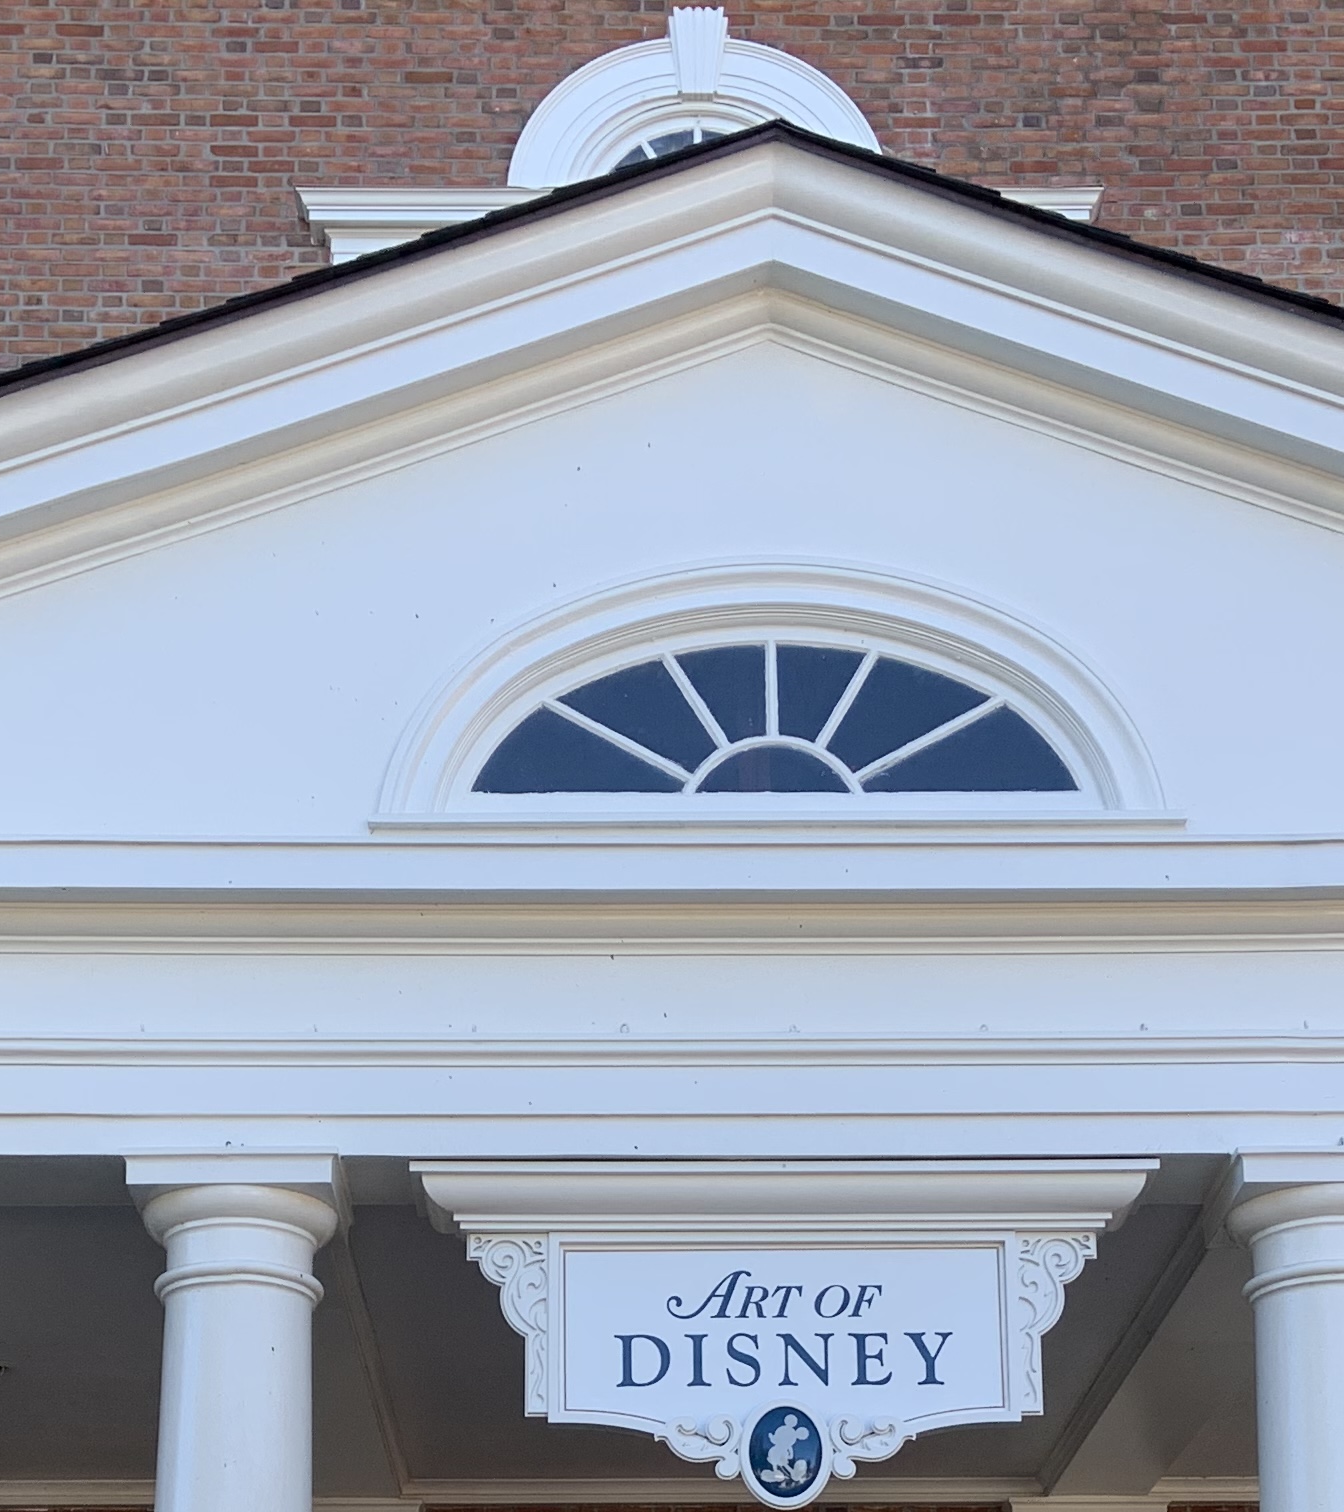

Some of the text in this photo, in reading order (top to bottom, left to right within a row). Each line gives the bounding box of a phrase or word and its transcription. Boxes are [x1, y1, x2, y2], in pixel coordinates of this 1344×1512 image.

[666, 1270, 883, 1320] ART OF
[613, 1331, 954, 1388] DISNEY
